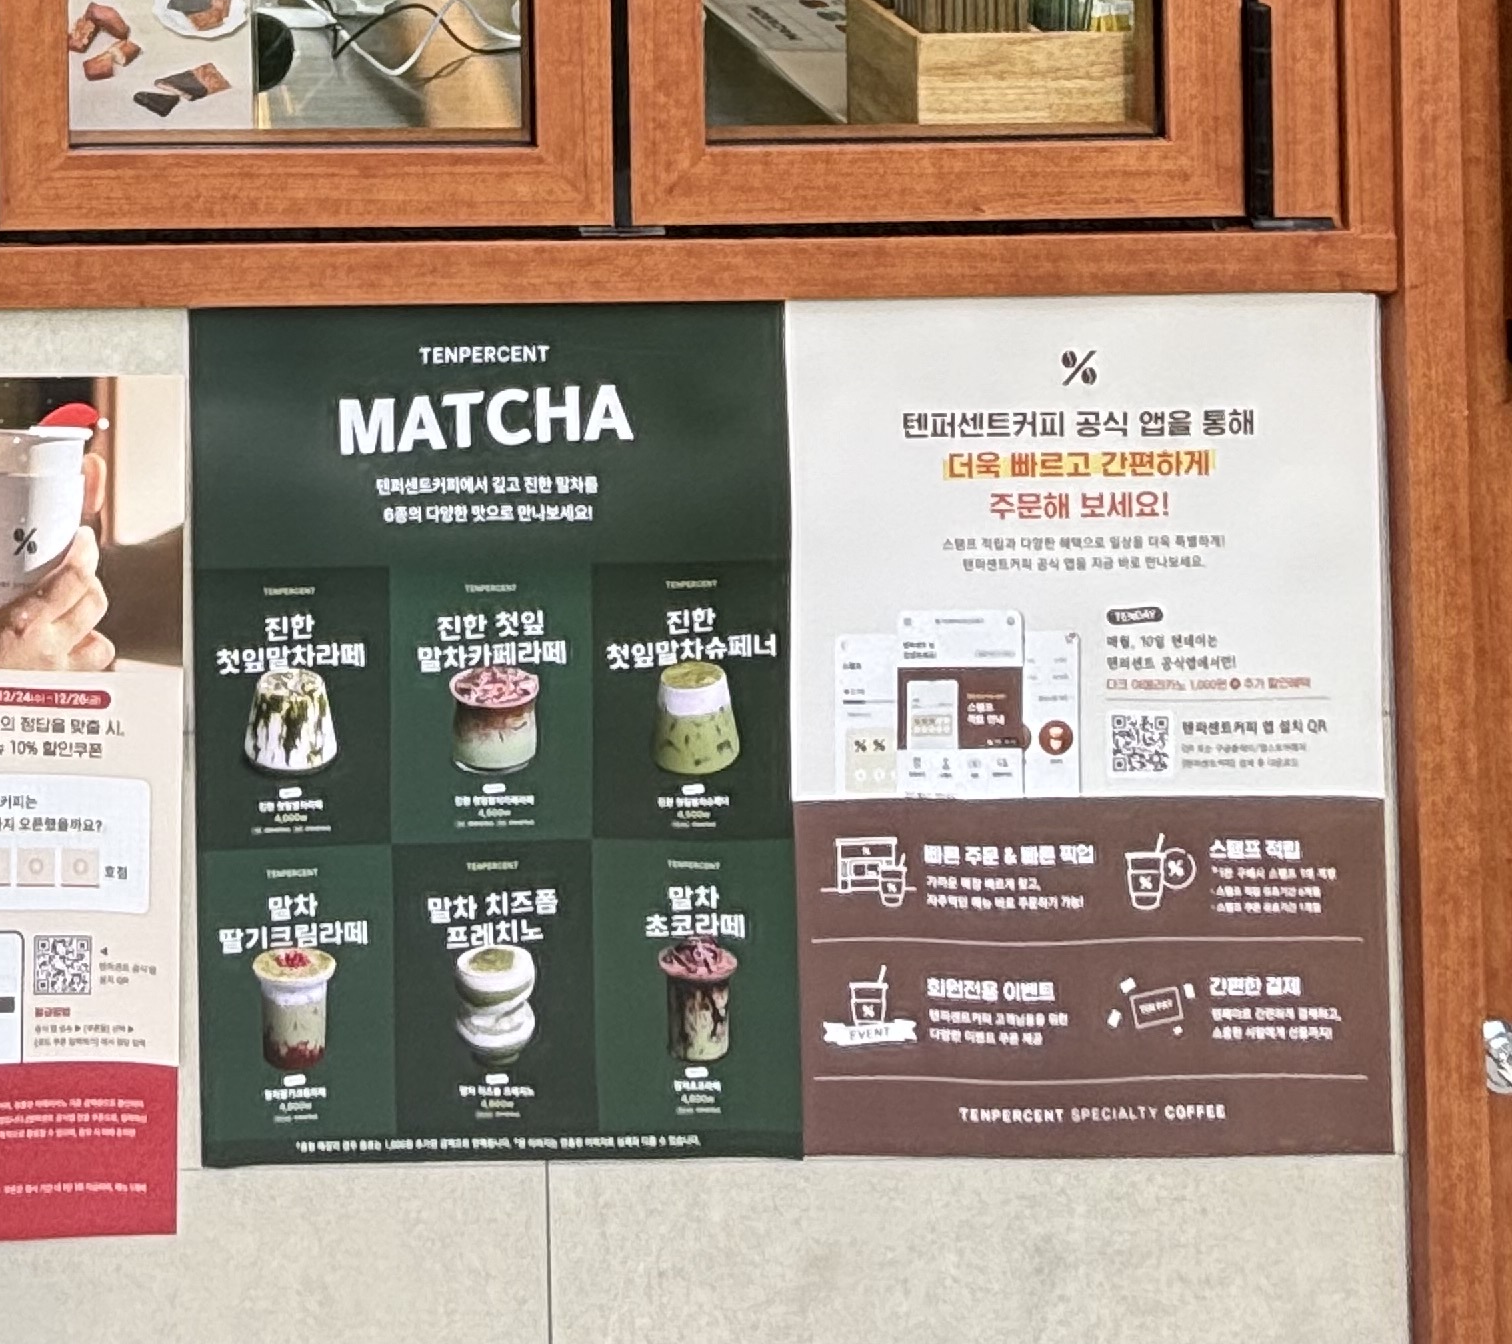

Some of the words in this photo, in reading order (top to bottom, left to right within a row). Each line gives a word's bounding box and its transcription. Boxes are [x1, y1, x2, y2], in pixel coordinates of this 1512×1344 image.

[419, 344, 550, 365] TENPERCENT
[339, 384, 635, 456] MATCHA
[902, 410, 1065, 439] 텐퍼센트커피
[1076, 410, 1128, 438] 공식
[1139, 409, 1193, 437] 앱을
[1202, 407, 1255, 437] 통해
[948, 451, 1001, 479] 더욱
[1011, 450, 1090, 478] 빠르고
[1101, 449, 1210, 477] 간편하게
[492, 475, 521, 495] 깊고
[524, 475, 552, 495] 진한
[425, 505, 468, 523] 다양한
[989, 492, 1070, 521] 주문해
[1080, 490, 1170, 520] 보세요!
[264, 613, 315, 642] 진한
[437, 613, 488, 642] 진한
[495, 609, 545, 638] 첫잎
[666, 607, 716, 636] 진한
[216, 642, 366, 675] 첫잎말차라떼
[417, 639, 567, 674] 말차카페라떼
[605, 632, 777, 671] 첫잎말차슈페너
[10, 740, 38, 757] 10%
[42, 740, 103, 759] 할인쿠폰
[964, 845, 999, 866] 주문
[1004, 846, 1018, 865] &
[1209, 838, 1262, 860] 스탬프
[268, 892, 318, 922] 말차
[427, 894, 478, 924] 말차
[485, 888, 559, 917] 치즈폼
[668, 884, 720, 912] 말차
[218, 920, 369, 955] 딸기크림라떼
[446, 918, 544, 950] 프레치노
[645, 912, 746, 940] 초코라떼
[1003, 980, 1056, 1002] 이벤트
[1209, 976, 1262, 997] 간편한
[849, 1027, 891, 1042] EVENT
[958, 1106, 1064, 1124] TENPERCENT
[1070, 1105, 1158, 1123] SPECIALTY
[1164, 1103, 1227, 1121] COFFEE
